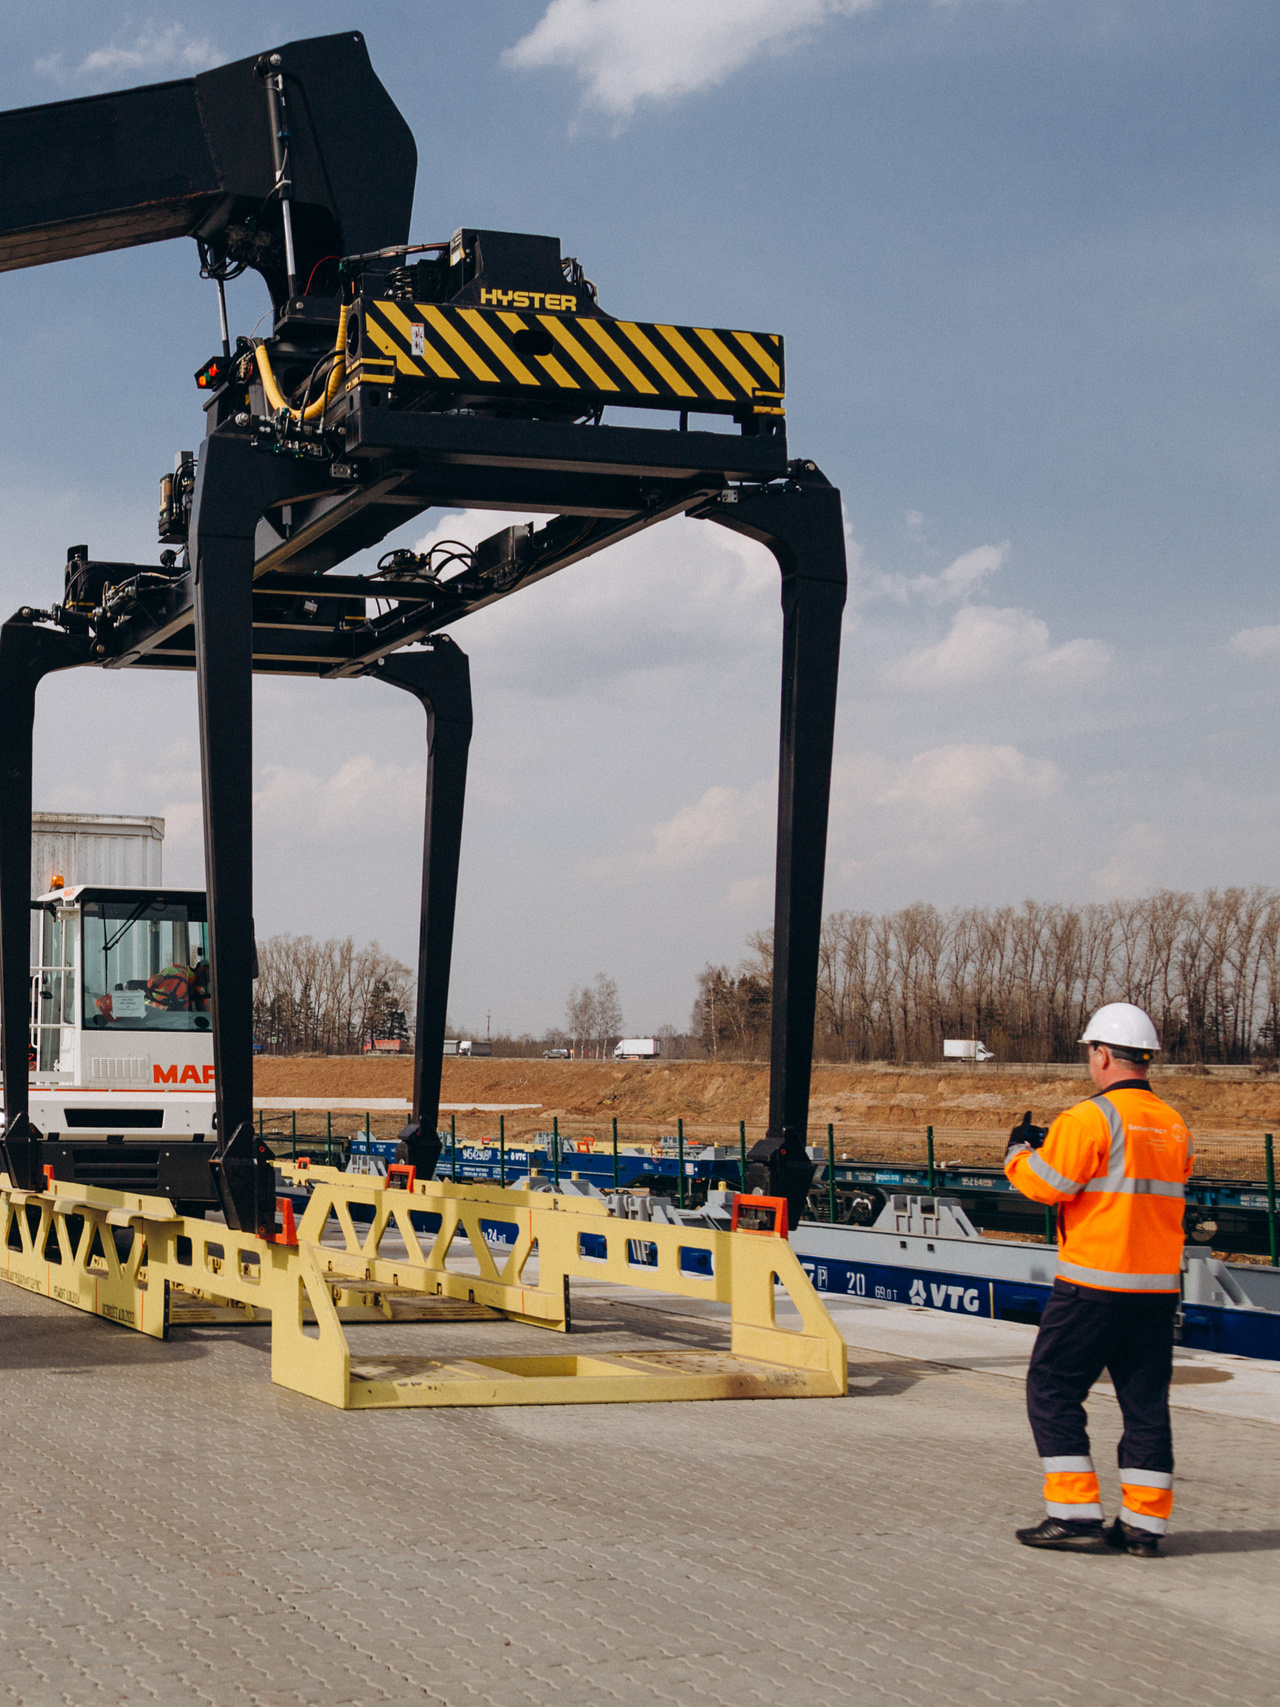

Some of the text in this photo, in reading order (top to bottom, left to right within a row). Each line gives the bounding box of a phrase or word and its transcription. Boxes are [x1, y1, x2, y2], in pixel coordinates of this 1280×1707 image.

[481, 288, 577, 312] HYSTER
[153, 1064, 216, 1084] MAF
[846, 1271, 865, 1296] 20
[930, 1283, 979, 1312] VTG
